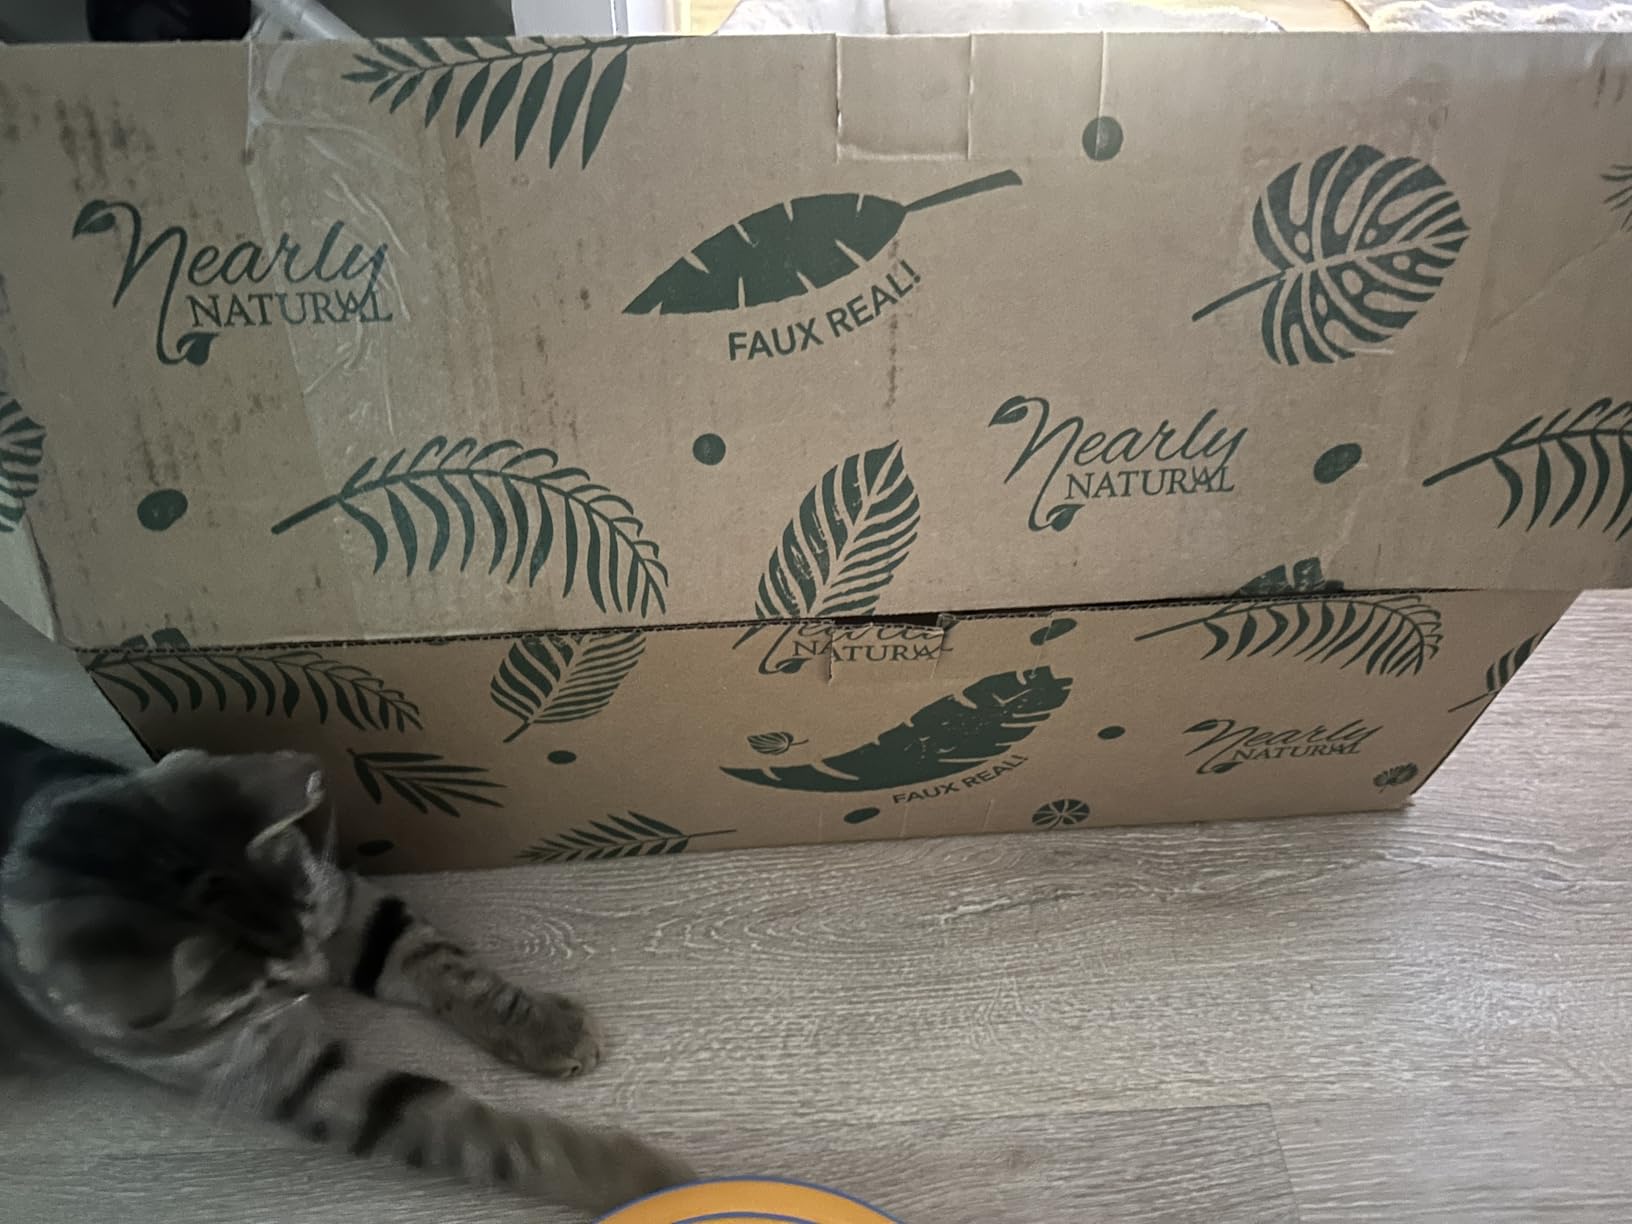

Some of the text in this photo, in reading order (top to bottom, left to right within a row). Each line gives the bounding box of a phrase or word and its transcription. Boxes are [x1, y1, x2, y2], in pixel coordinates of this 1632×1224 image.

[72, 199, 389, 366] Nearly
[185, 288, 393, 328] NATURAL
[728, 259, 921, 361] FAUX REAL!
[988, 395, 1249, 532] Nearly
[1064, 464, 1236, 500] NATURAL
[1182, 718, 1384, 775] Nearly
[1232, 742, 1362, 761] NATURAL
[892, 753, 1029, 804] FAUX REAL!
